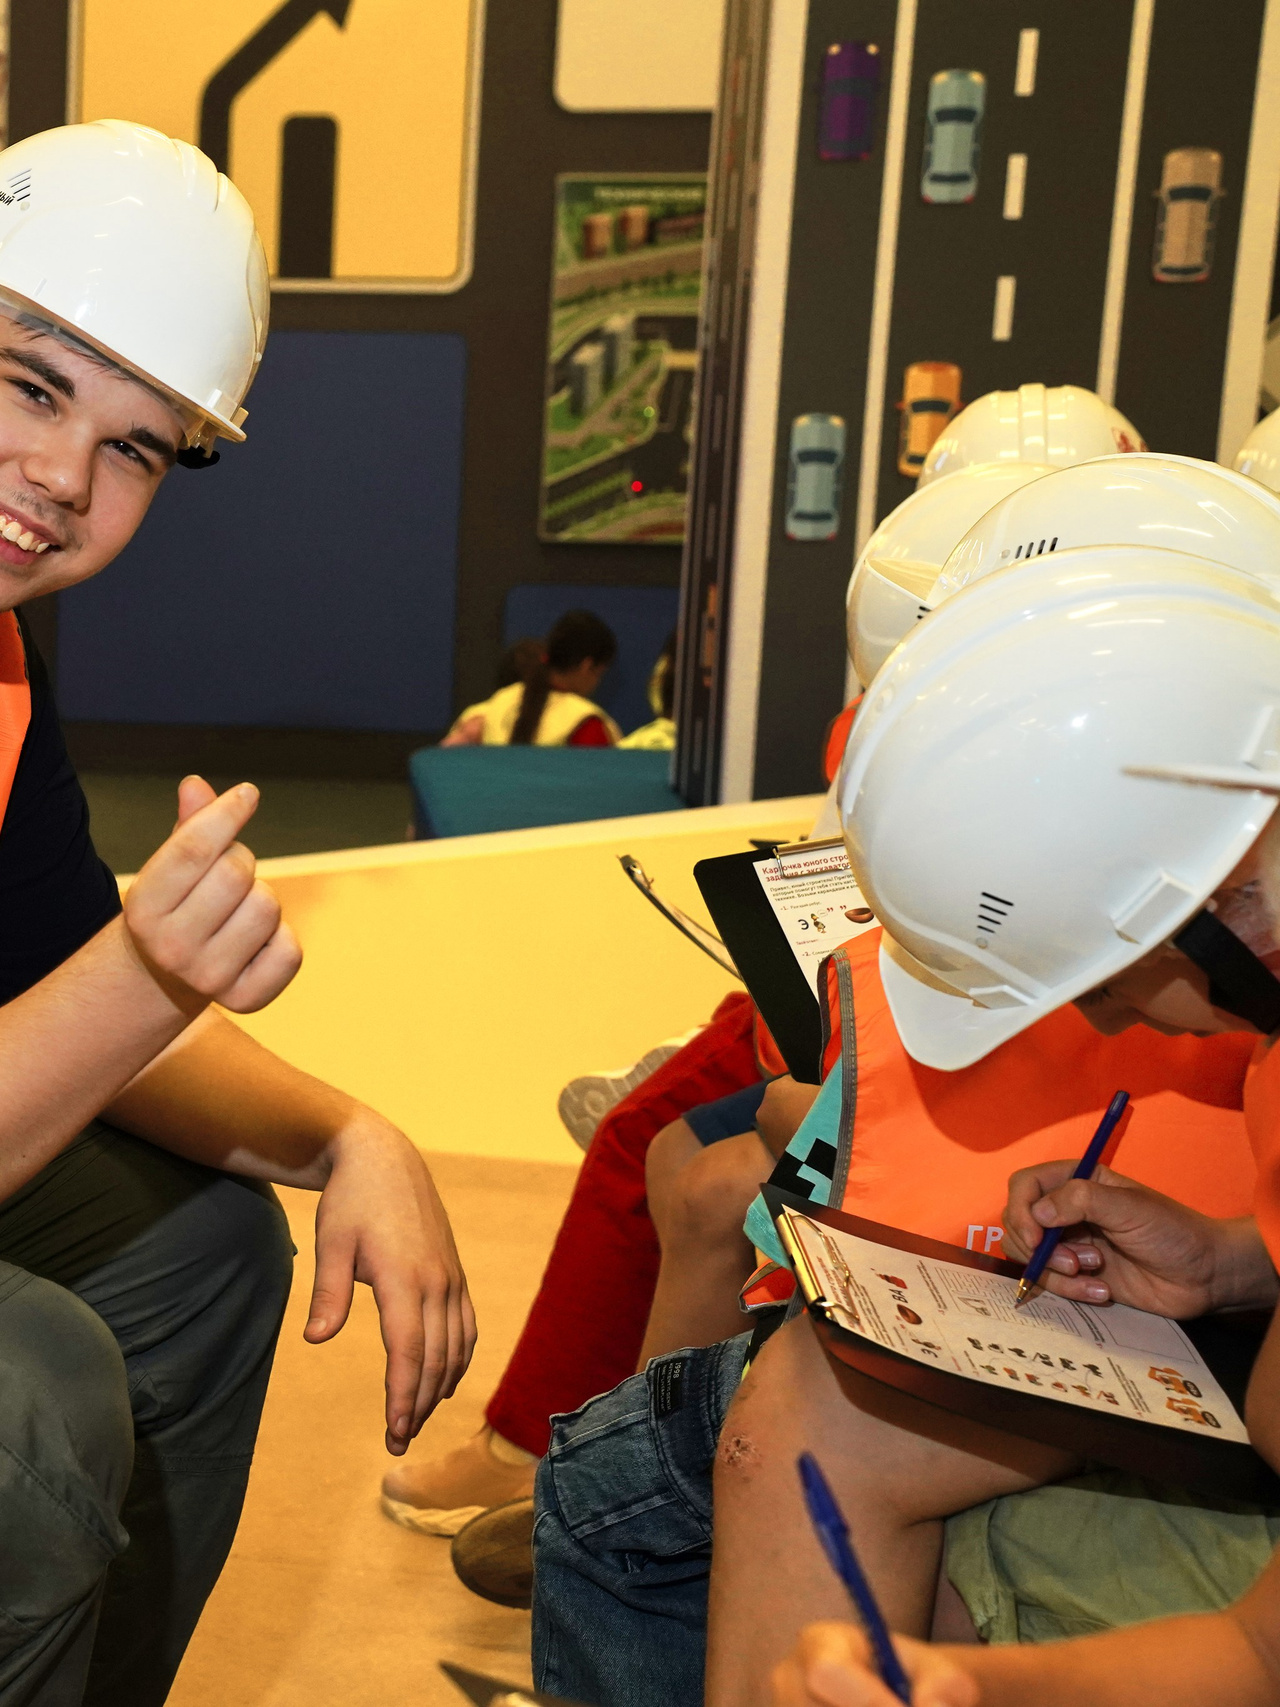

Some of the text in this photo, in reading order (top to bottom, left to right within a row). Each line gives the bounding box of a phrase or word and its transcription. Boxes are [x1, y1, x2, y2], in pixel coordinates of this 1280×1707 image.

[804, 857, 829, 868] юного
[797, 919, 809, 931] Э
[673, 1362, 682, 1378] 1998
